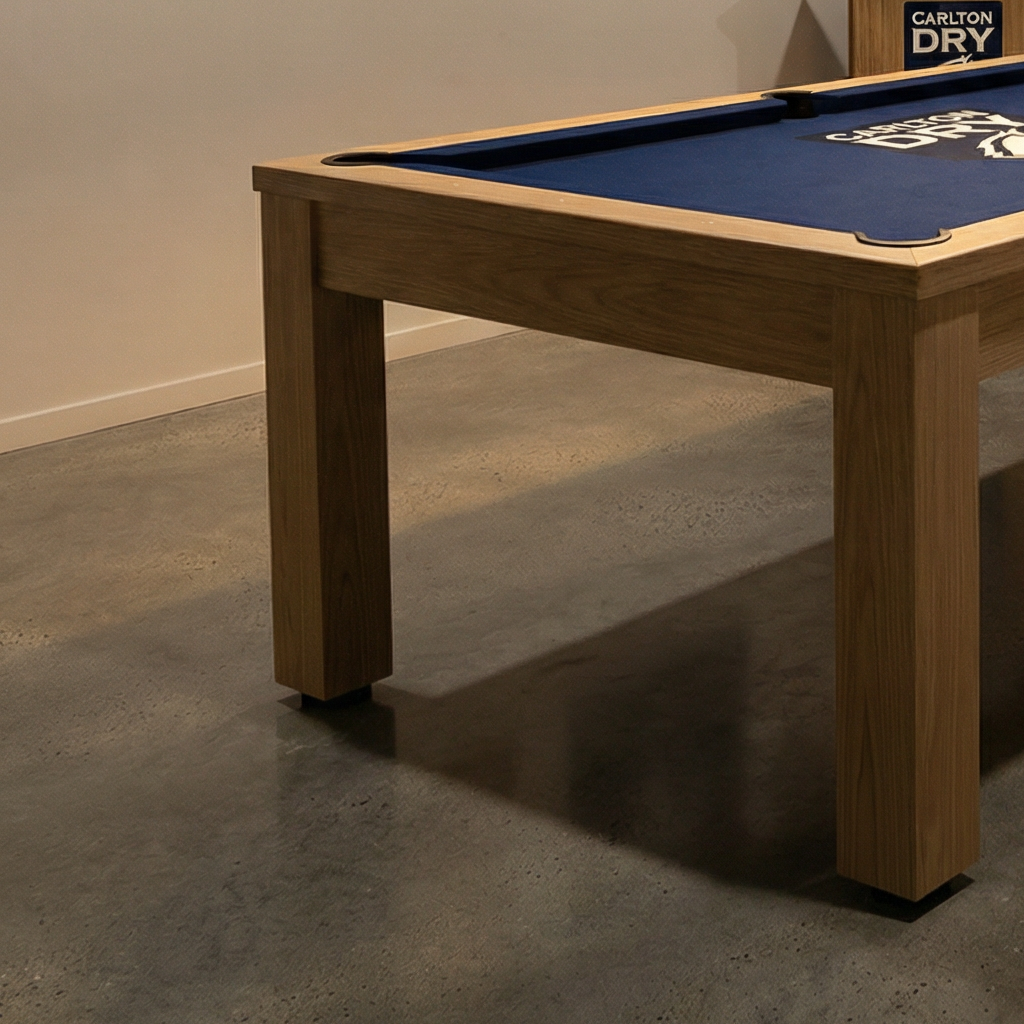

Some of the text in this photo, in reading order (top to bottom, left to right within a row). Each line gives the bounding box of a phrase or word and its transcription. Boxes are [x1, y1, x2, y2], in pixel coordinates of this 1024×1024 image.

[912, 11, 992, 25] CARLTON
[911, 27, 995, 53] DRY
[825, 110, 990, 141] CARLTON
